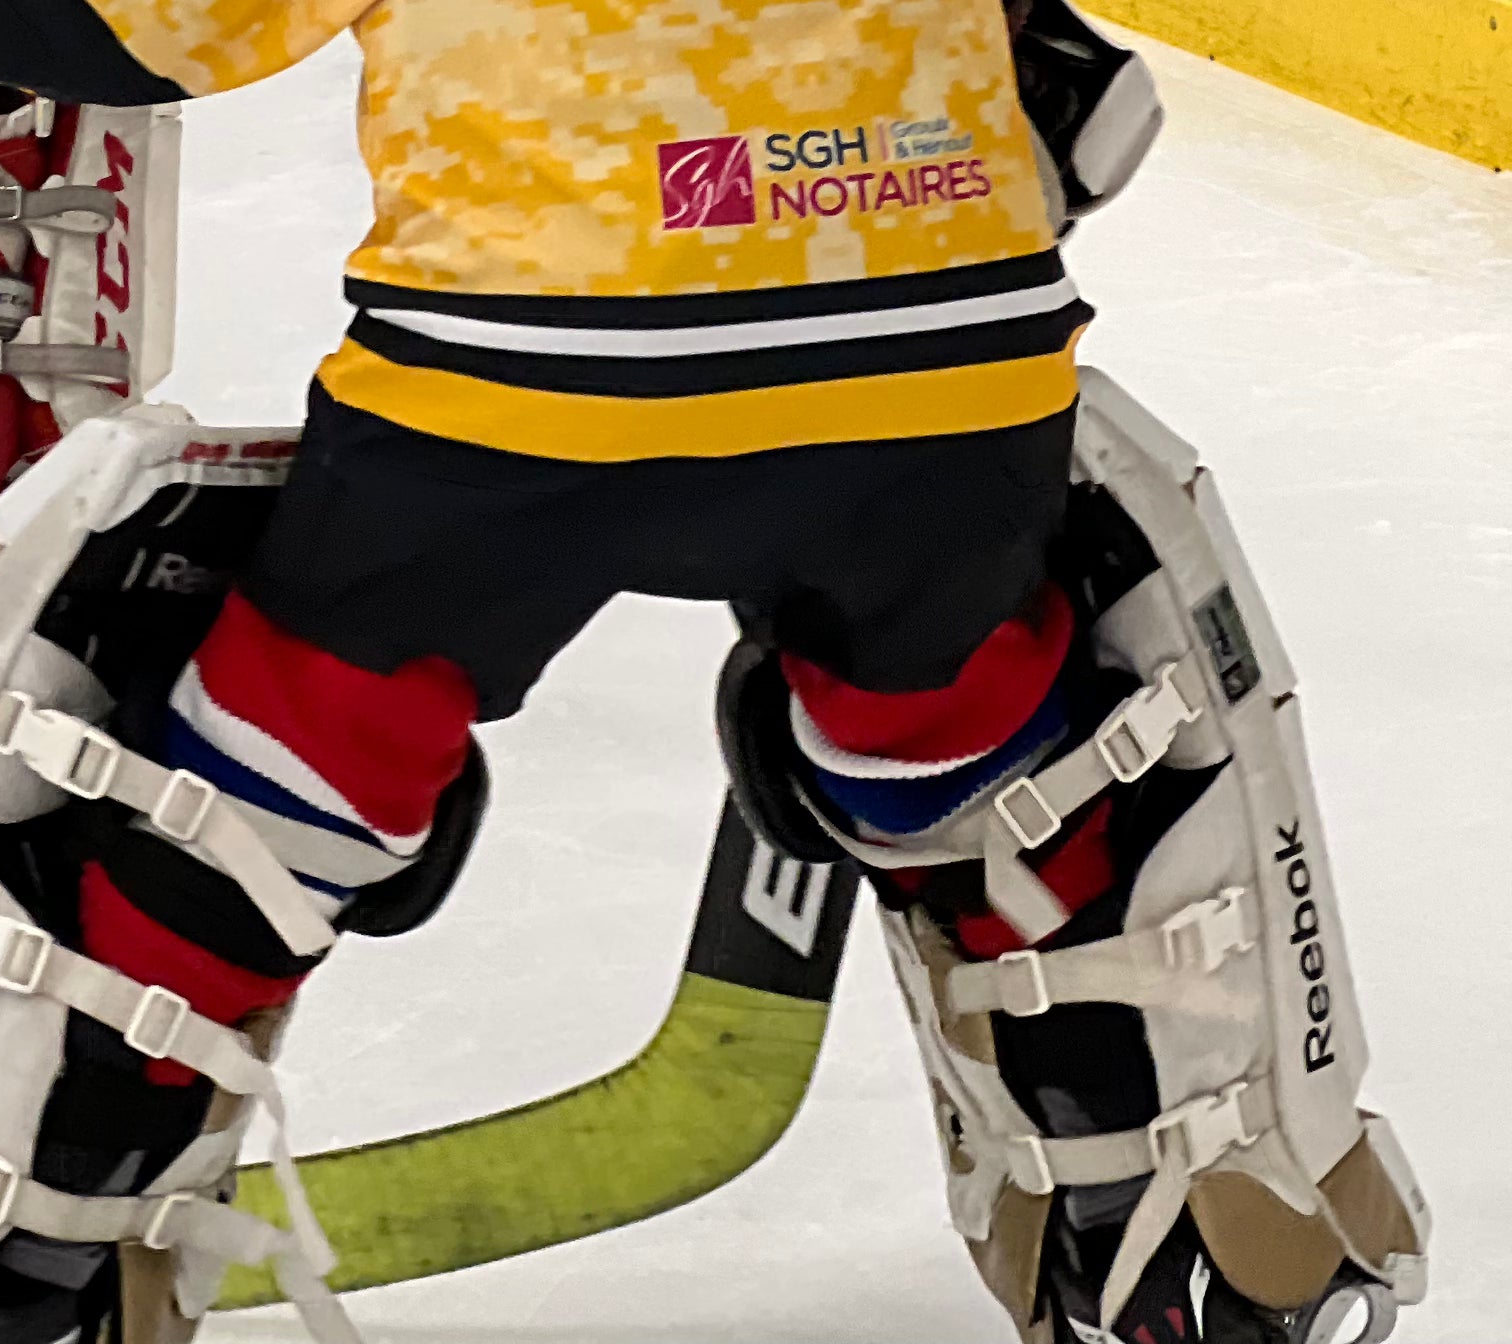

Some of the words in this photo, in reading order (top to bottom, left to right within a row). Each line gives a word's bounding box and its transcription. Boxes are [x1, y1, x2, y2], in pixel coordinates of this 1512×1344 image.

[765, 126, 869, 172] SGH
[770, 159, 992, 221] NOTAIRES
[1274, 816, 1336, 1074] Reebok
